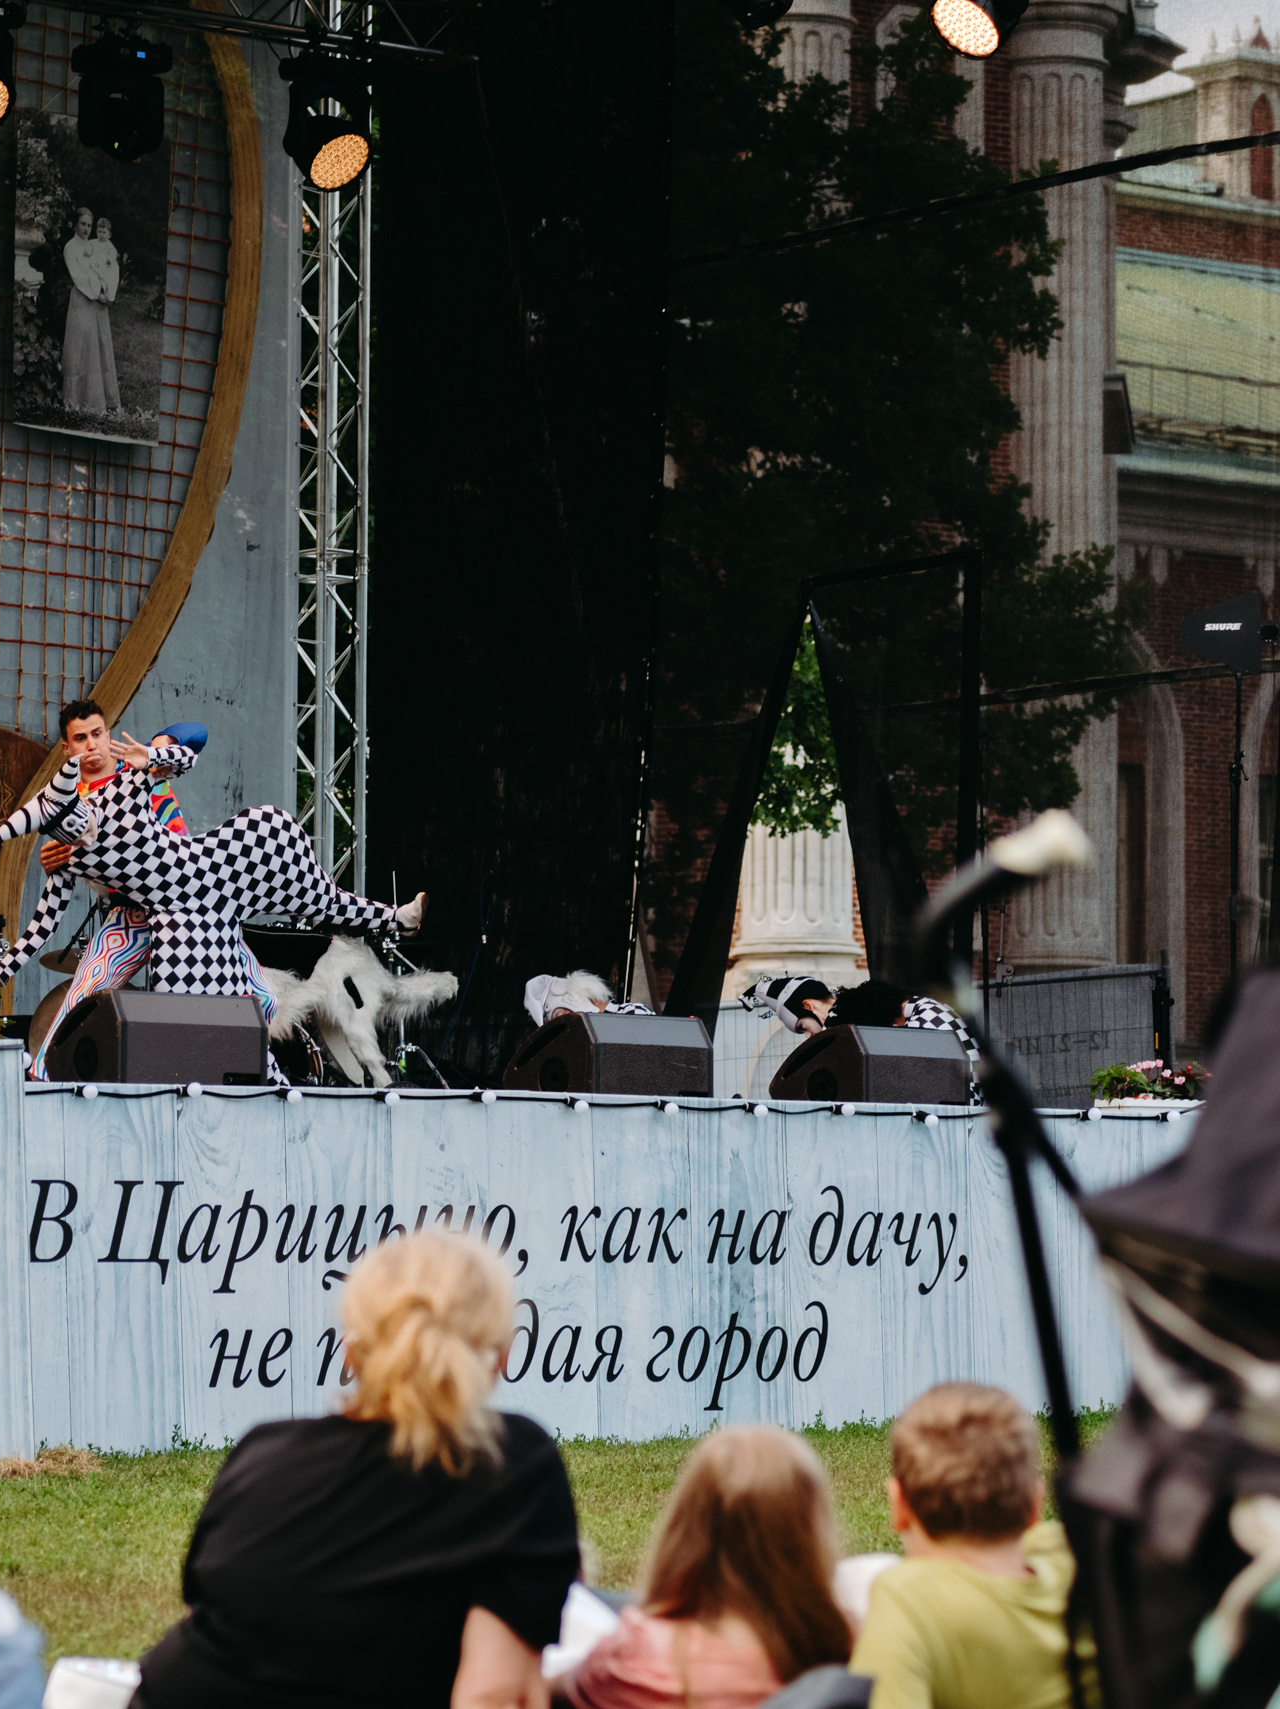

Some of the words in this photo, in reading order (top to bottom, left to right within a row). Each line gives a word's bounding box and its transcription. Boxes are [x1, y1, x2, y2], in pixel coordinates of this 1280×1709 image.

[1204, 623, 1242, 631] SHURE
[29, 1179, 78, 1263] В
[560, 1205, 688, 1264] как
[706, 1208, 788, 1266] на
[808, 1185, 969, 1296] дачу,
[208, 1327, 293, 1389] не
[646, 1300, 829, 1411] город
